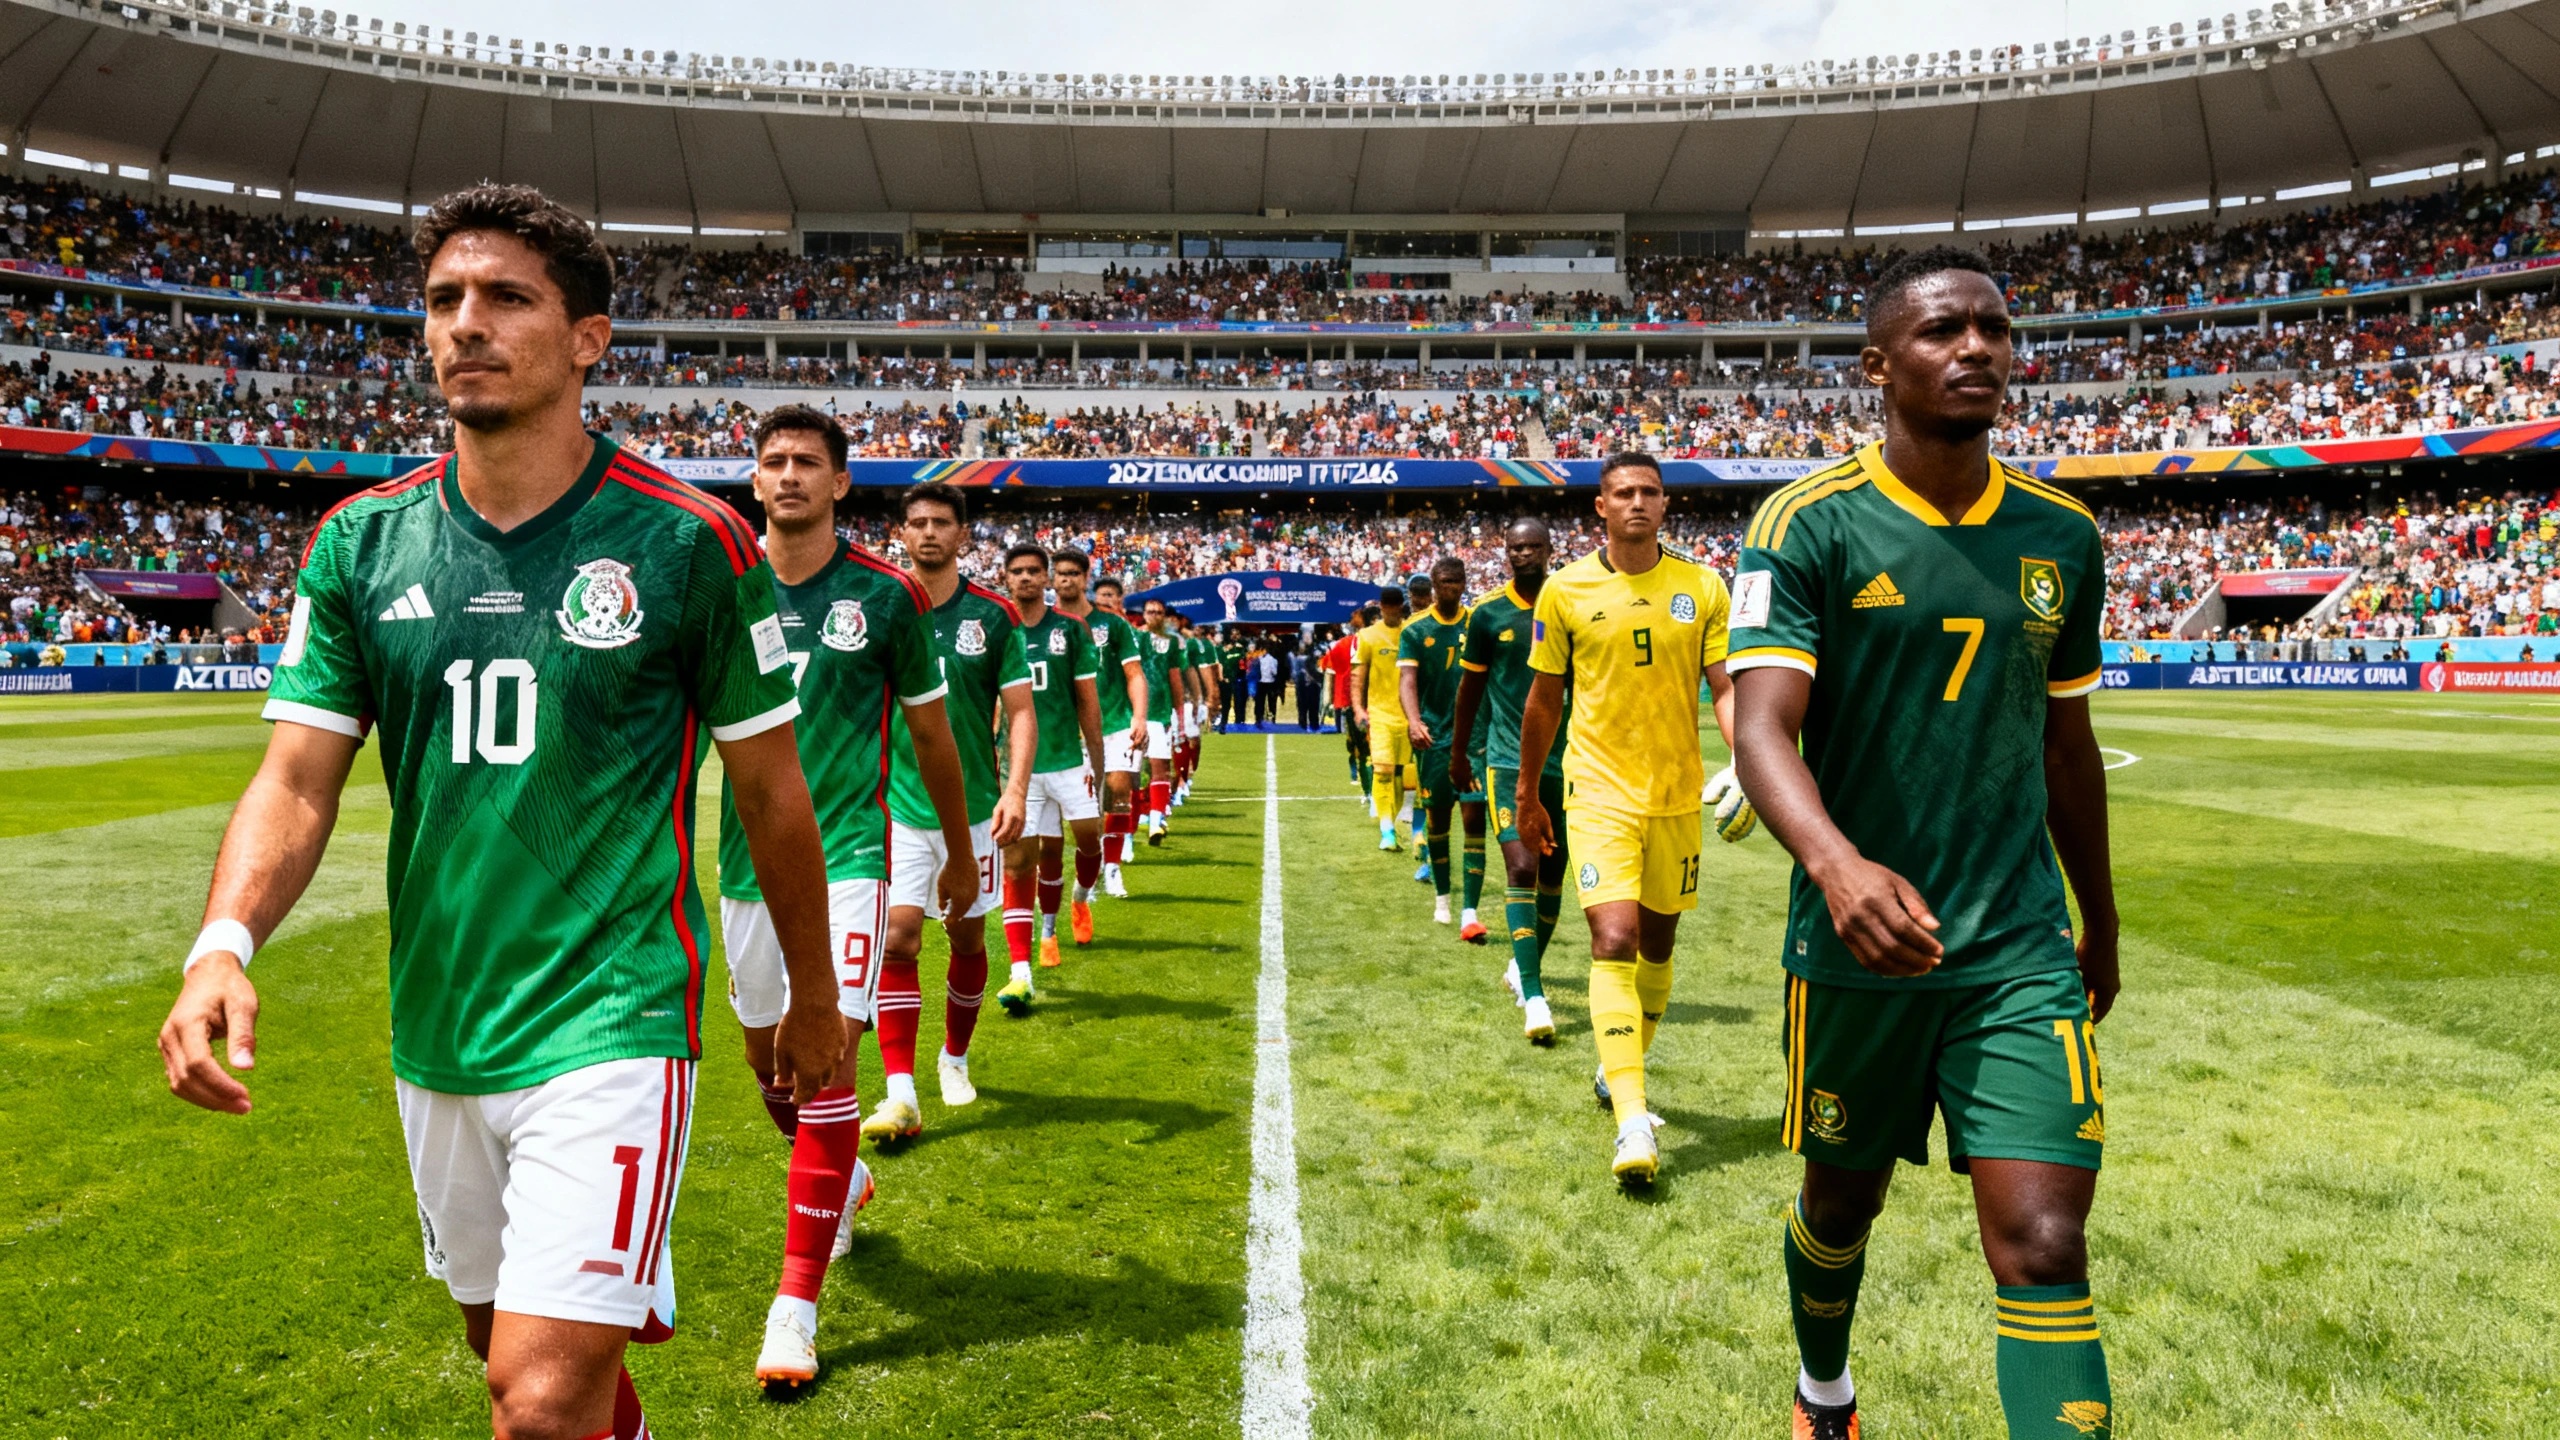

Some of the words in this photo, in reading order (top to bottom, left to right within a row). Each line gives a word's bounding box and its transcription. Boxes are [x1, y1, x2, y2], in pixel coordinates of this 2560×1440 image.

[1633, 627, 1653, 667] 9
[1943, 617, 1984, 701] 7
[443, 658, 538, 766] 10
[843, 932, 871, 988] 9
